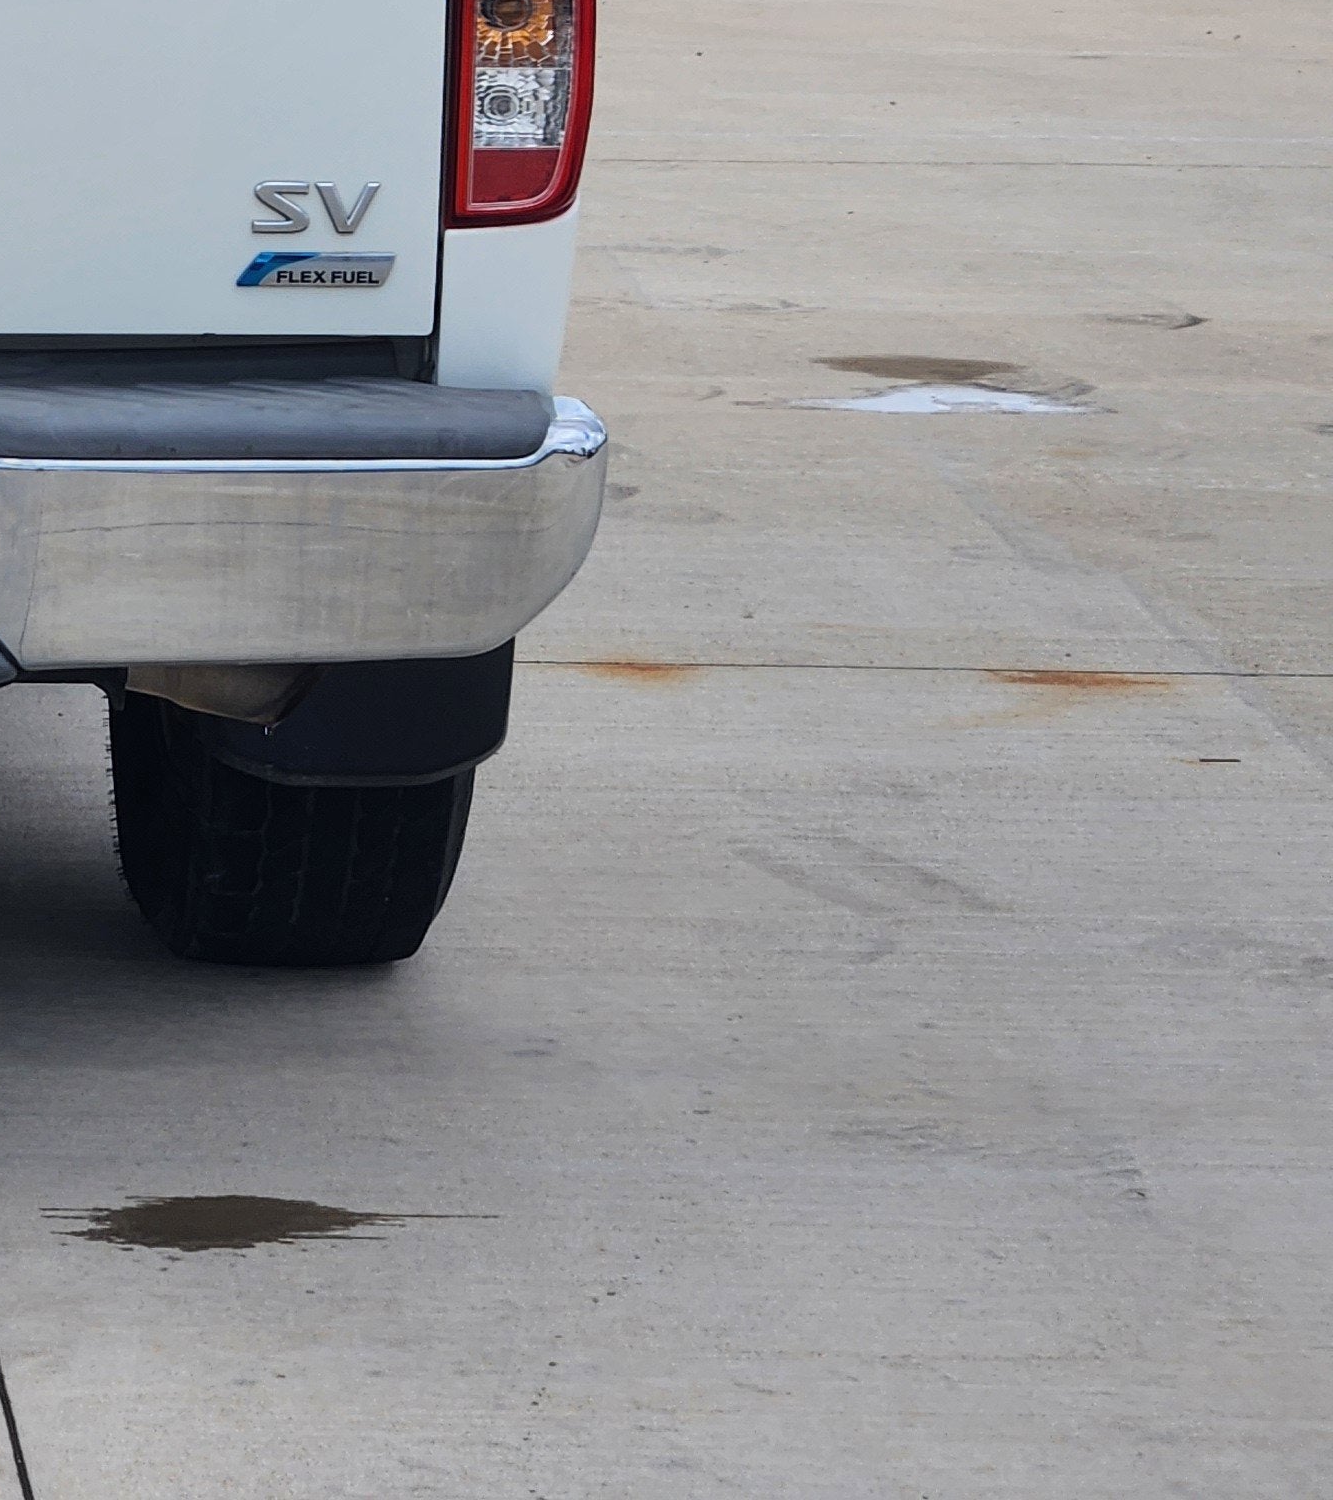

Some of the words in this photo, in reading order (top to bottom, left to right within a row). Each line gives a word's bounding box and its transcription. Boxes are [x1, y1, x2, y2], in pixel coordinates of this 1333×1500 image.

[251, 180, 381, 234] SV
[276, 270, 326, 284] FLEX
[330, 270, 380, 284] FUEL
